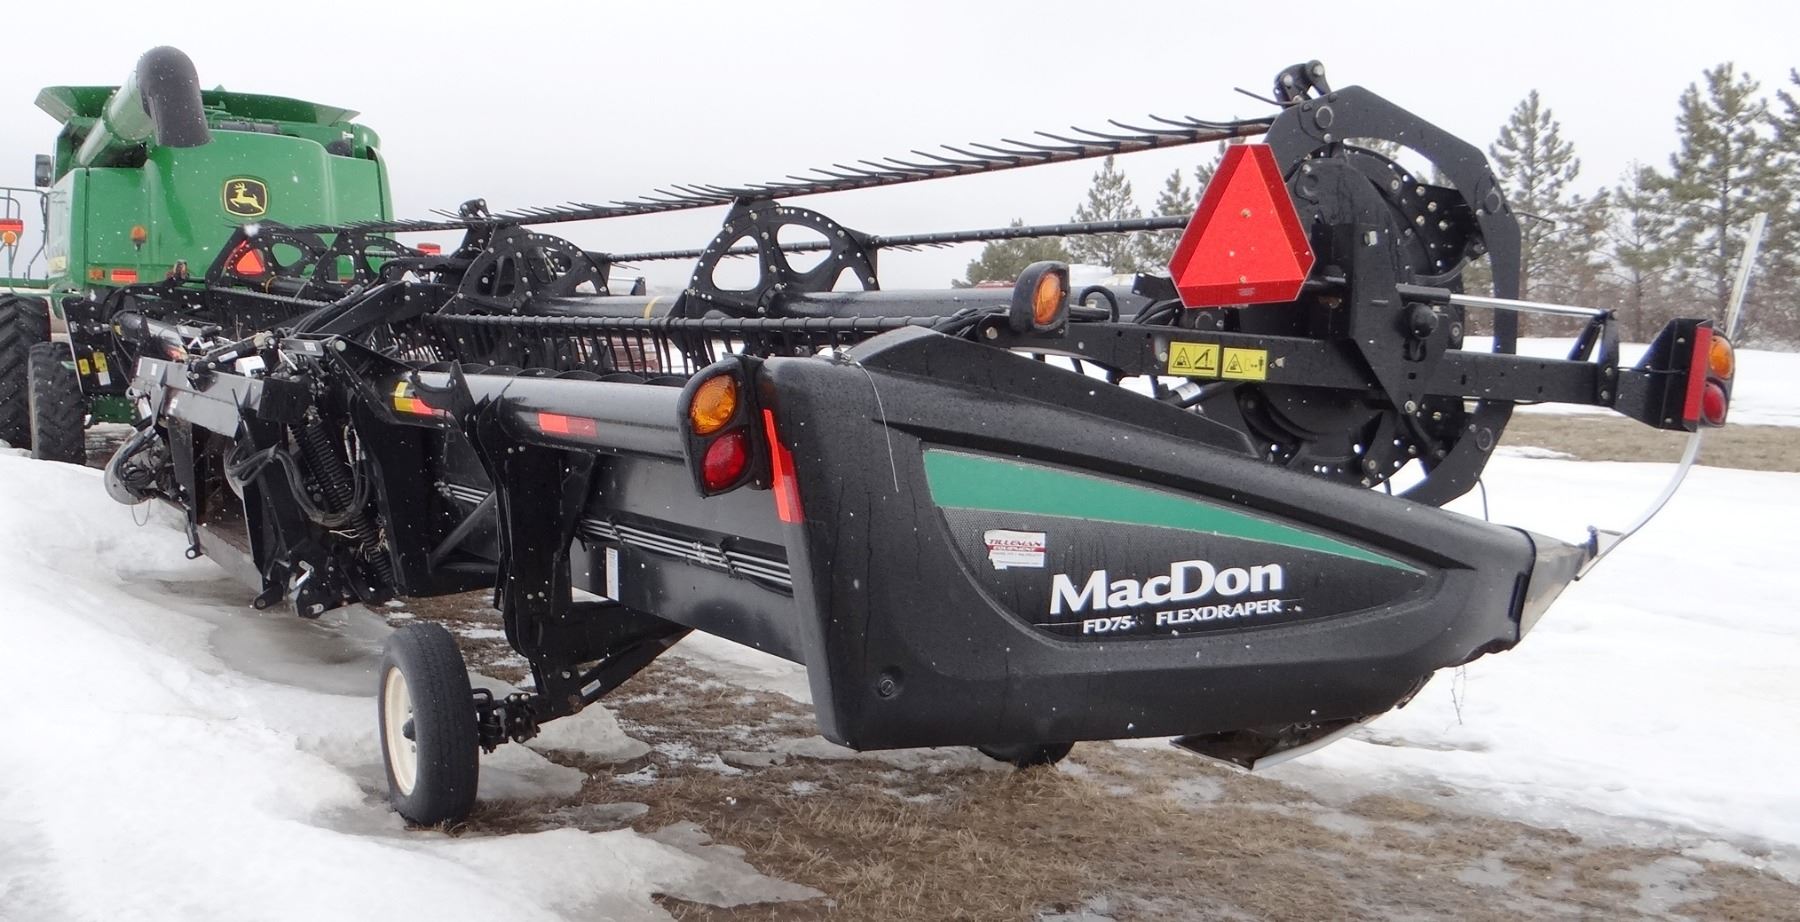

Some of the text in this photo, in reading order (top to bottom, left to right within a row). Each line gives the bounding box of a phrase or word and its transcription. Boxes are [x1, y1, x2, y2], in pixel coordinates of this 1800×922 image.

[988, 538, 1042, 547] TILLEMAN
[1050, 559, 1283, 615] MacDon
[1155, 599, 1282, 626] FLEXDRAPER
